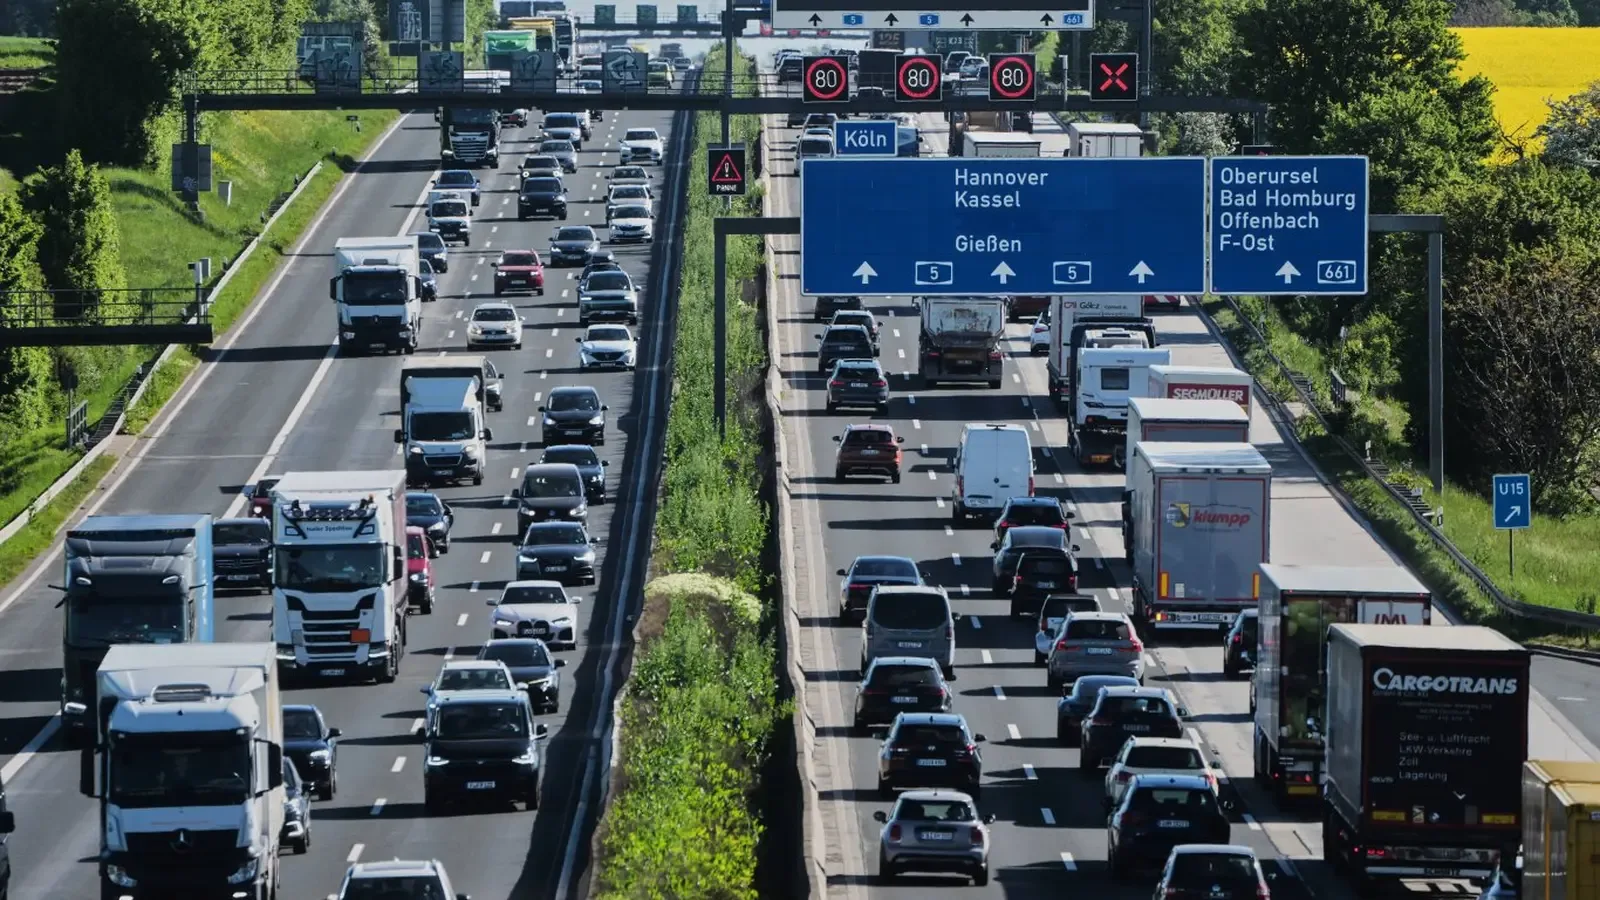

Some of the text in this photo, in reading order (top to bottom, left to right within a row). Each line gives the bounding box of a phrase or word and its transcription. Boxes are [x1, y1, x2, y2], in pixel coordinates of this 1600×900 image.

[1066, 14, 1081, 24] 661
[815, 69, 837, 88] 80
[907, 68, 929, 87] 80
[1001, 68, 1023, 87] 80
[845, 130, 887, 147] Köln
[955, 168, 1048, 185] Hannover
[1220, 167, 1318, 184] Oberursel
[955, 191, 1020, 207] Kassel
[1220, 190, 1356, 210] Bad Homburg
[1220, 212, 1319, 229] Offenbach
[955, 235, 1021, 252] Gießen
[1220, 234, 1275, 251] F-Ost
[930, 266, 938, 280] 5
[1068, 266, 1076, 280] 5
[1325, 265, 1349, 279] 661
[1173, 387, 1244, 401] SEGMÜLLER
[1499, 483, 1524, 495] U15
[1194, 510, 1250, 527] klumpp
[1373, 667, 1517, 694] CARGOTRANS
[1440, 733, 1491, 745] Luftfracht
[1399, 757, 1418, 766] Zoll
[1399, 771, 1448, 782] Lagerung
